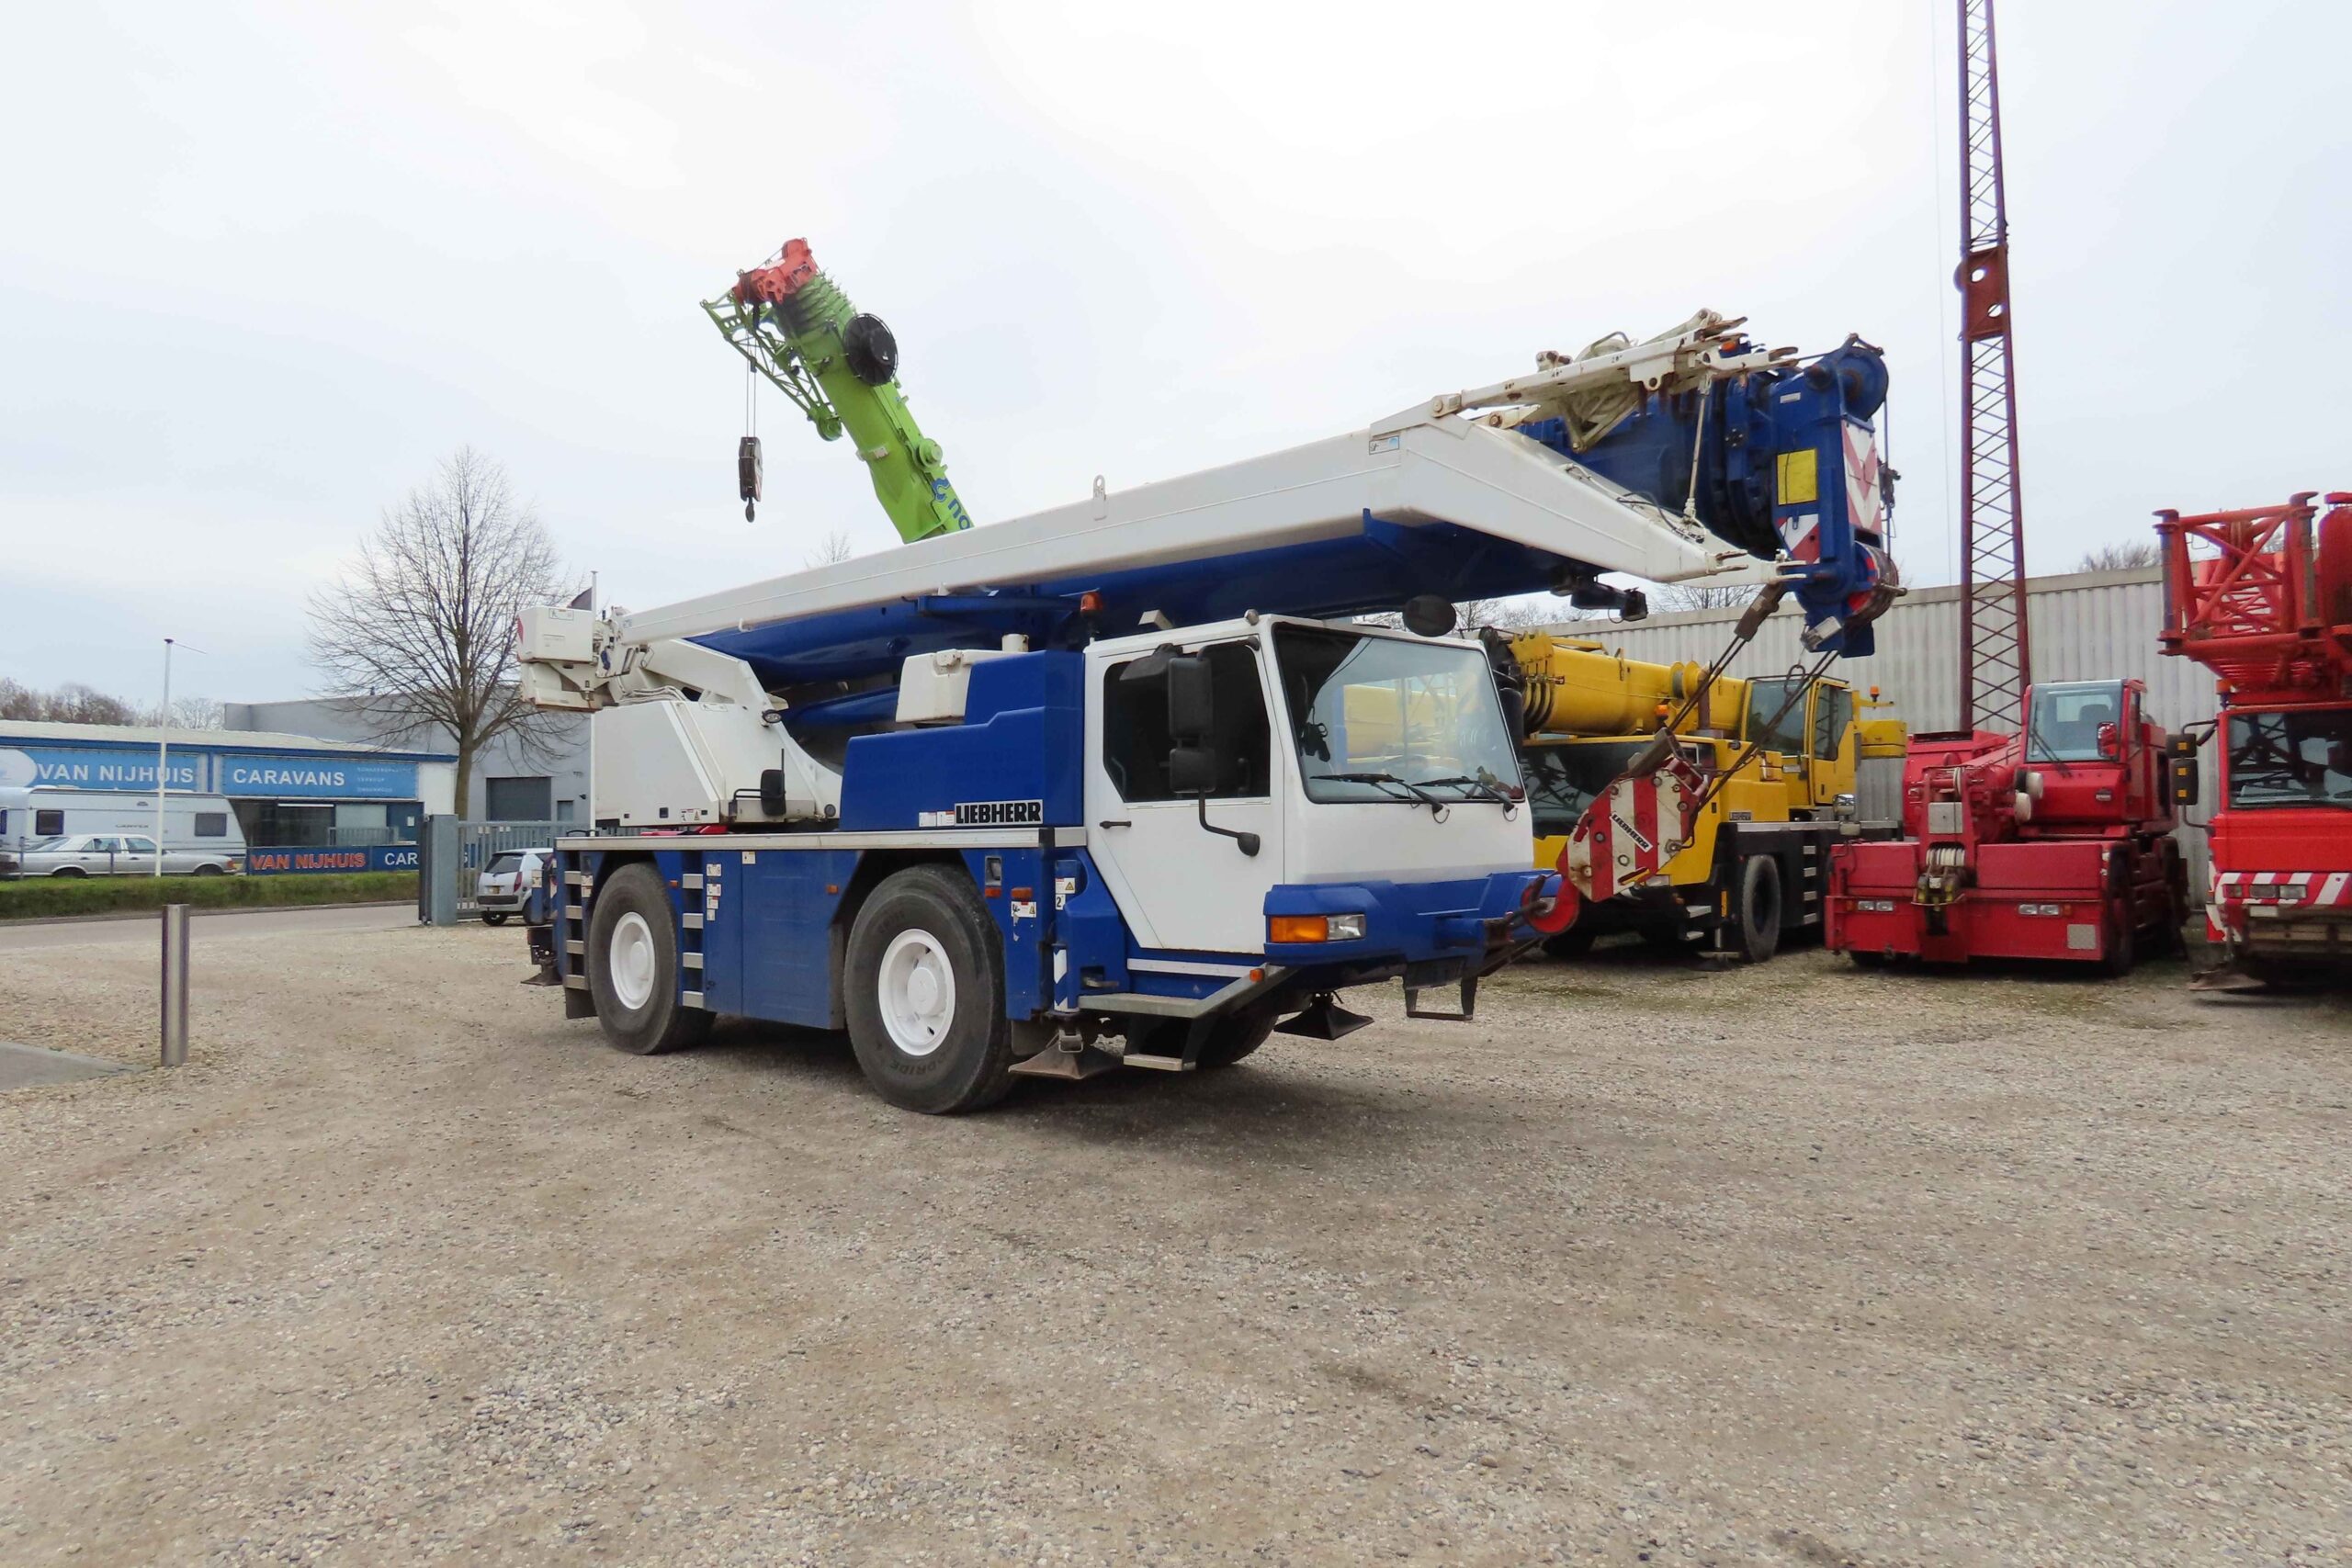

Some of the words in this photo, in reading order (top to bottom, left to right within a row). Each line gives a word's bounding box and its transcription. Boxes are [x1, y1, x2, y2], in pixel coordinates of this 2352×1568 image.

[38, 763, 88, 781] VAN
[99, 764, 194, 783] NIJHUIS
[233, 768, 345, 786] CARAVANS
[956, 802, 1041, 824] LIEBHERR
[1611, 814, 1650, 850] LIEBHERR
[251, 854, 290, 870] VAN
[296, 852, 366, 869] NIJHUIS
